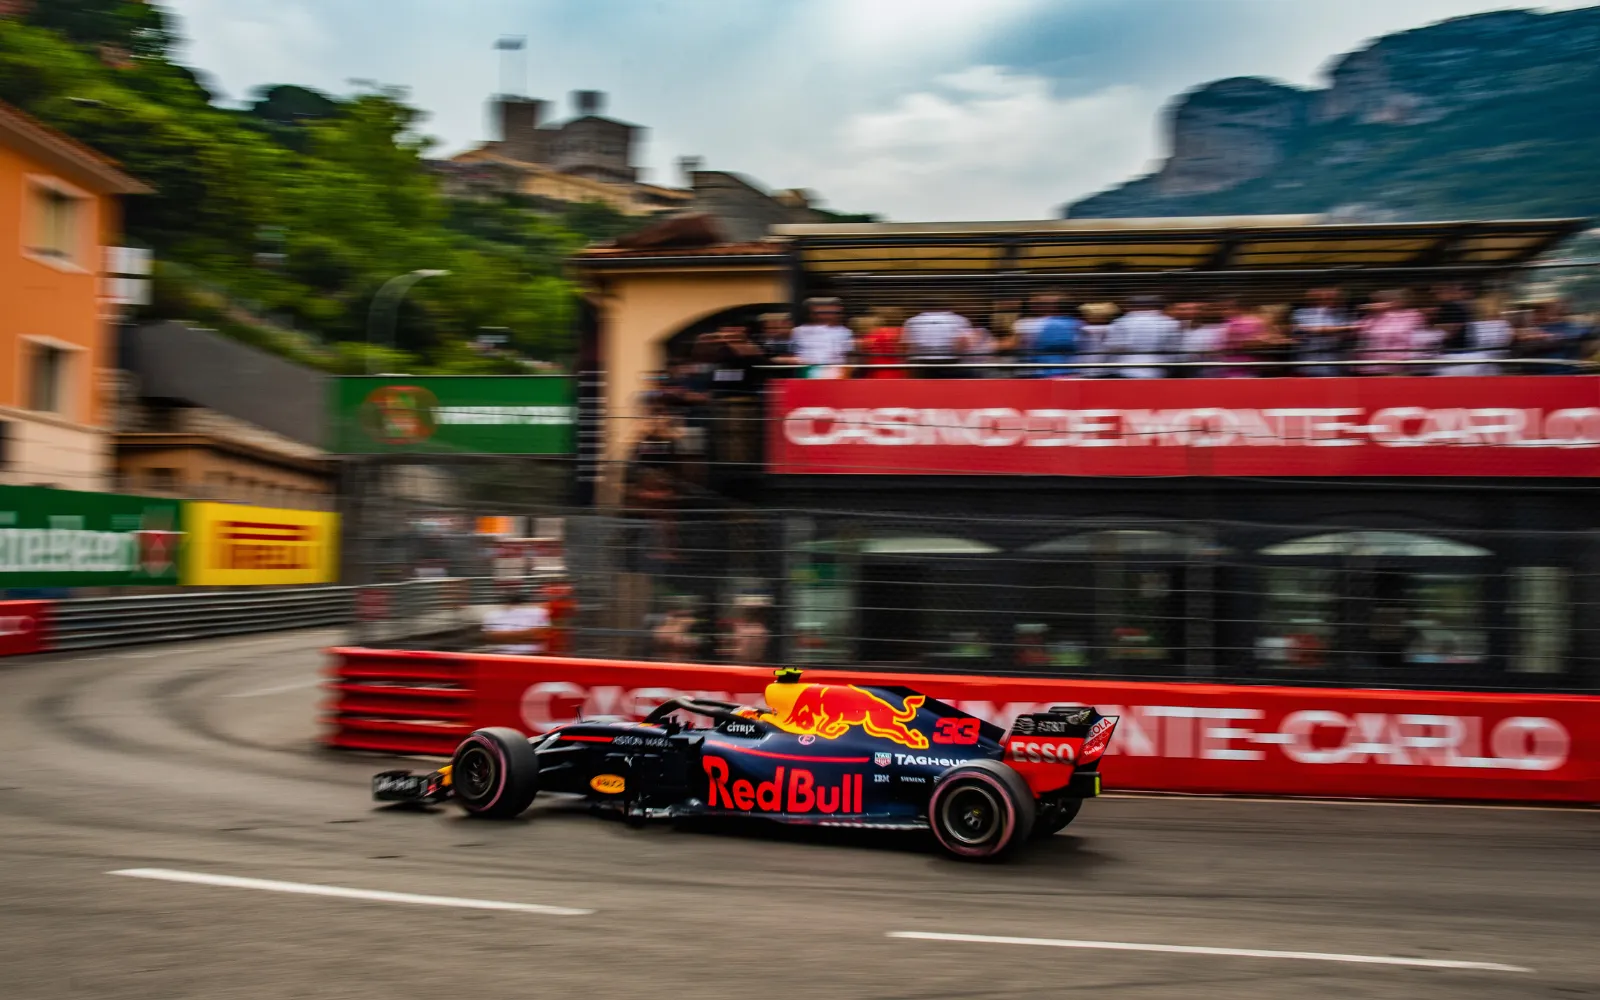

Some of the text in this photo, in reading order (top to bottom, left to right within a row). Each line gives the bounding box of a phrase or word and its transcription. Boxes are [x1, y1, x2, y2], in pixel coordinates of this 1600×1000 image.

[784, 406, 1600, 449] CASINO DE MONTE-CARLO
[520, 681, 766, 734] CAS
[933, 717, 981, 745] 33
[1011, 741, 1075, 765] ESSO
[874, 774, 890, 783] IBM
[900, 776, 926, 784] SIEMENS
